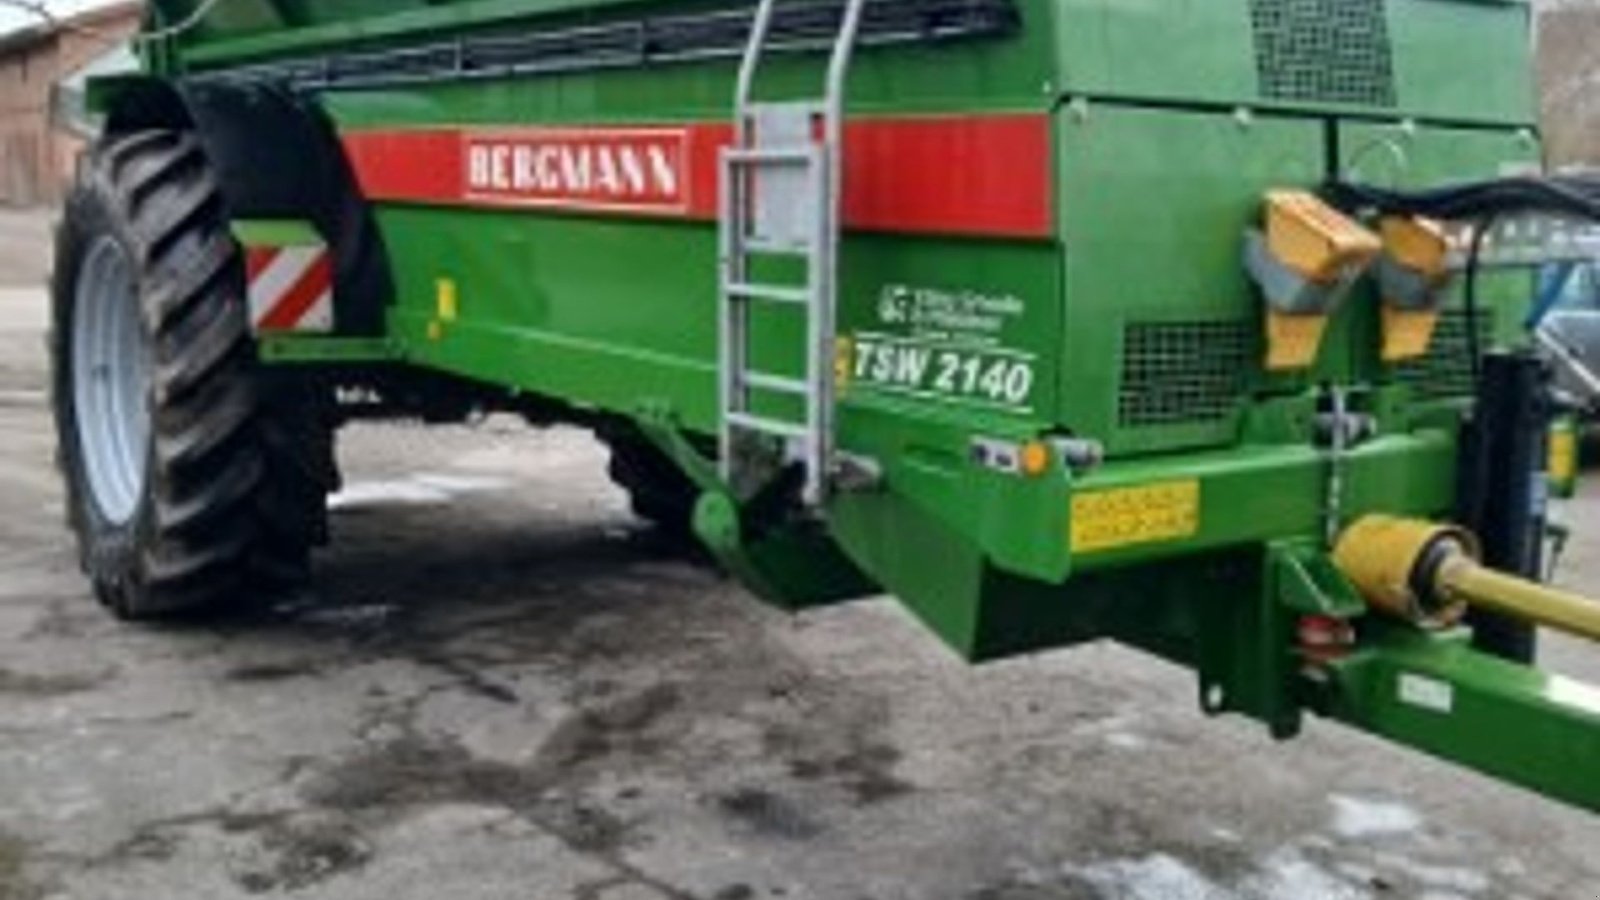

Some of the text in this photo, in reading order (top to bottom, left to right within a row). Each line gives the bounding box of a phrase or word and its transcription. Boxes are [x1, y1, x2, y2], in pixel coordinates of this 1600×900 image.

[469, 144, 677, 196] BERGMANN
[855, 342, 1033, 404] TSW 2140
